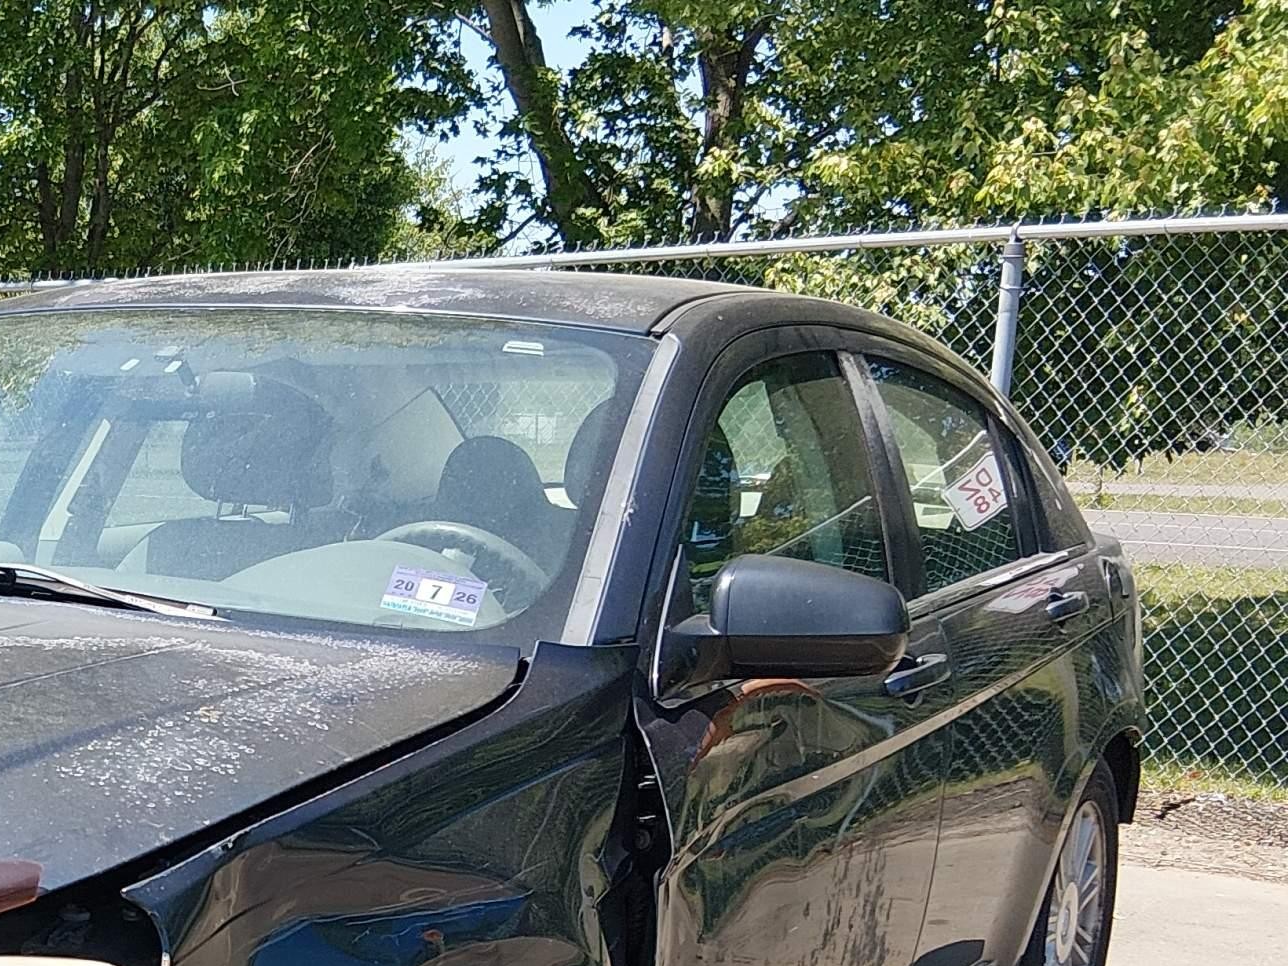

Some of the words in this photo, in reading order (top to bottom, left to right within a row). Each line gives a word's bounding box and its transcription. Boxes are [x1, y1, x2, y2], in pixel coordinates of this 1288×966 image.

[393, 579, 415, 592] 20
[431, 584, 443, 600] 7
[454, 591, 477, 604] 26
